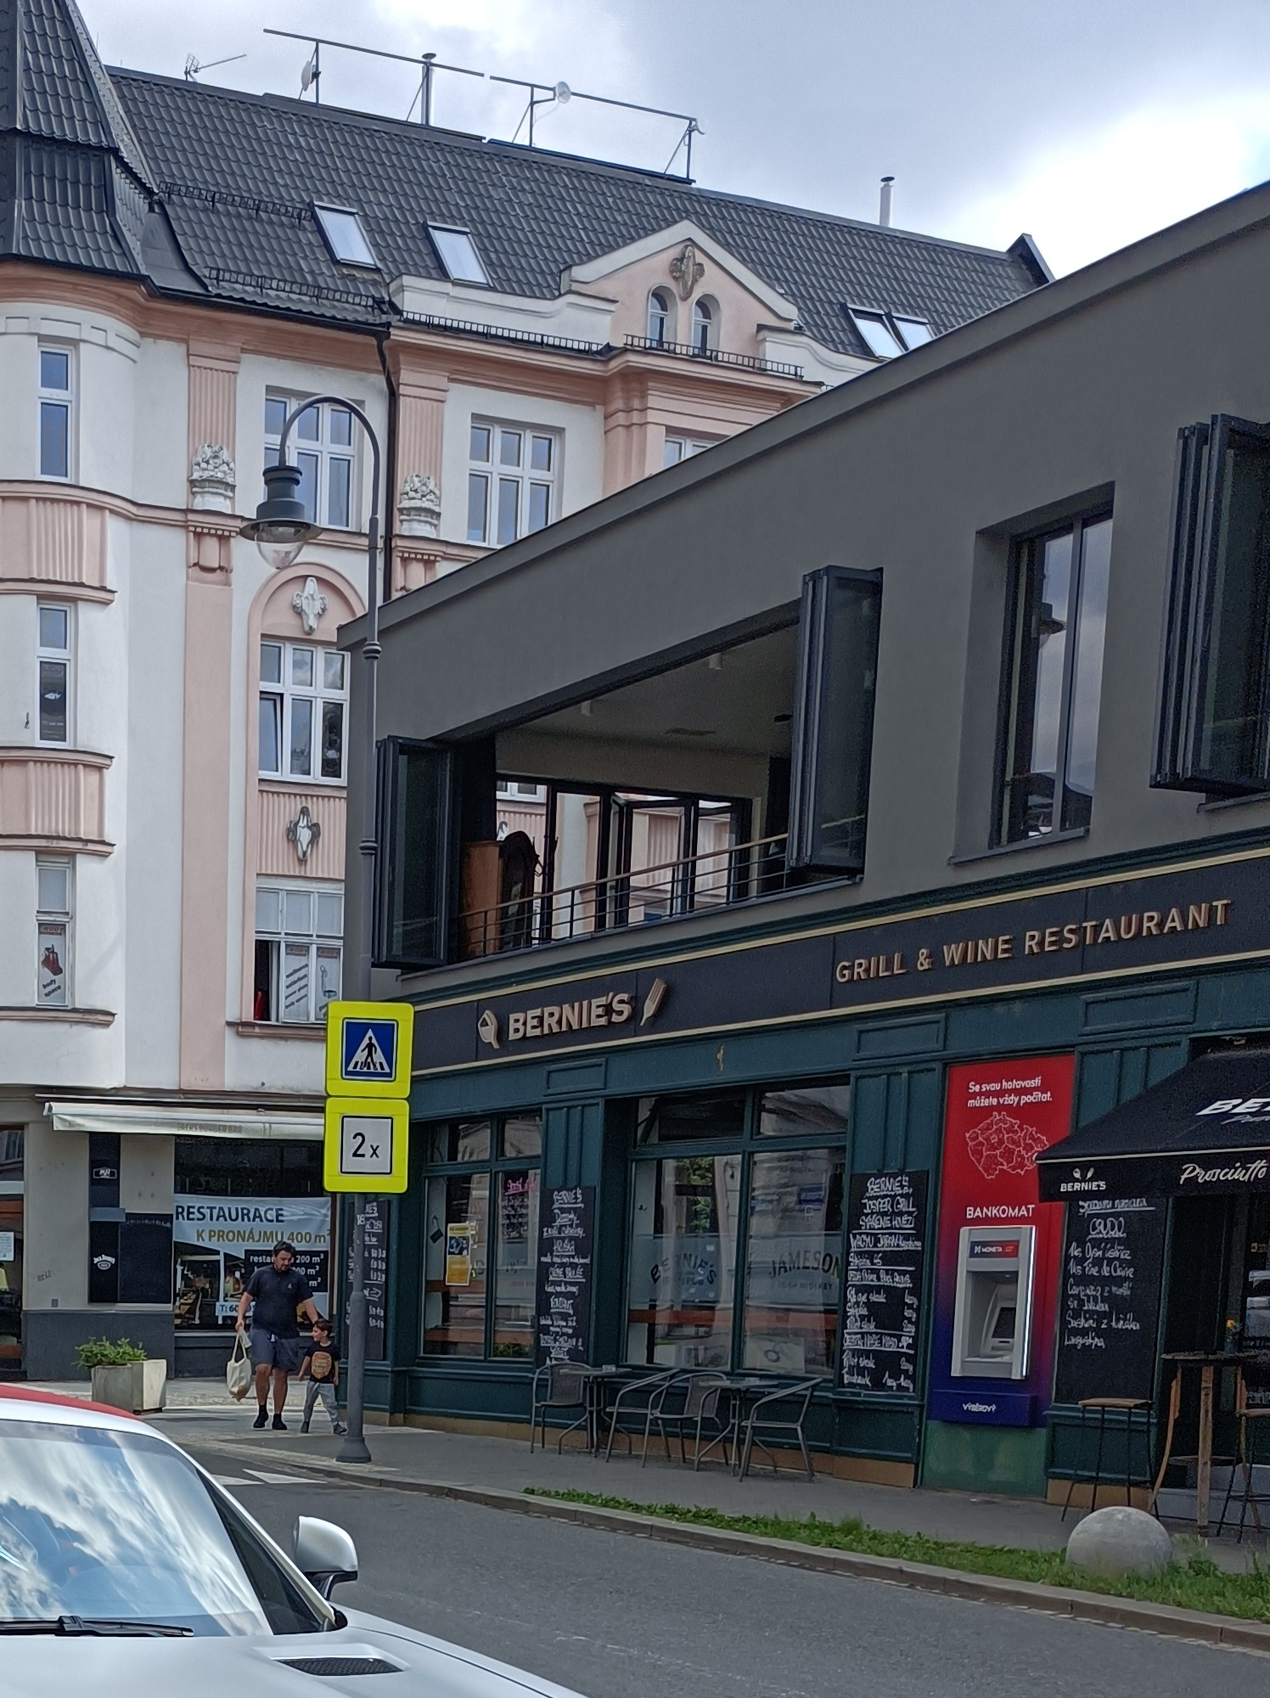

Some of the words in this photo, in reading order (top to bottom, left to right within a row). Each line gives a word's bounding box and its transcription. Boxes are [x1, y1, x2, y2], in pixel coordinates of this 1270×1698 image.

[835, 951, 907, 984] GRILL
[916, 947, 932, 971] &
[942, 934, 1014, 967] WINE
[1024, 899, 1232, 956] RESTAURANT
[508, 991, 633, 1040] BERNIE'S
[968, 1081, 980, 1093] Se
[981, 1082, 1001, 1092] svou
[1002, 1076, 1042, 1090] hotovostí
[967, 1095, 998, 1108] můžete
[998, 1093, 1019, 1108] vždy
[1060, 1181, 1107, 1192] BERNIE'S
[175, 1205, 285, 1224] RESTAURACE
[966, 1204, 1036, 1219] BANKOMAT
[196, 1229, 206, 1243] K
[208, 1227, 284, 1244] PRONÁJMU
[287, 1231, 312, 1244] 400
[295, 1254, 311, 1264] 200
[769, 1250, 842, 1279] JAMESON
